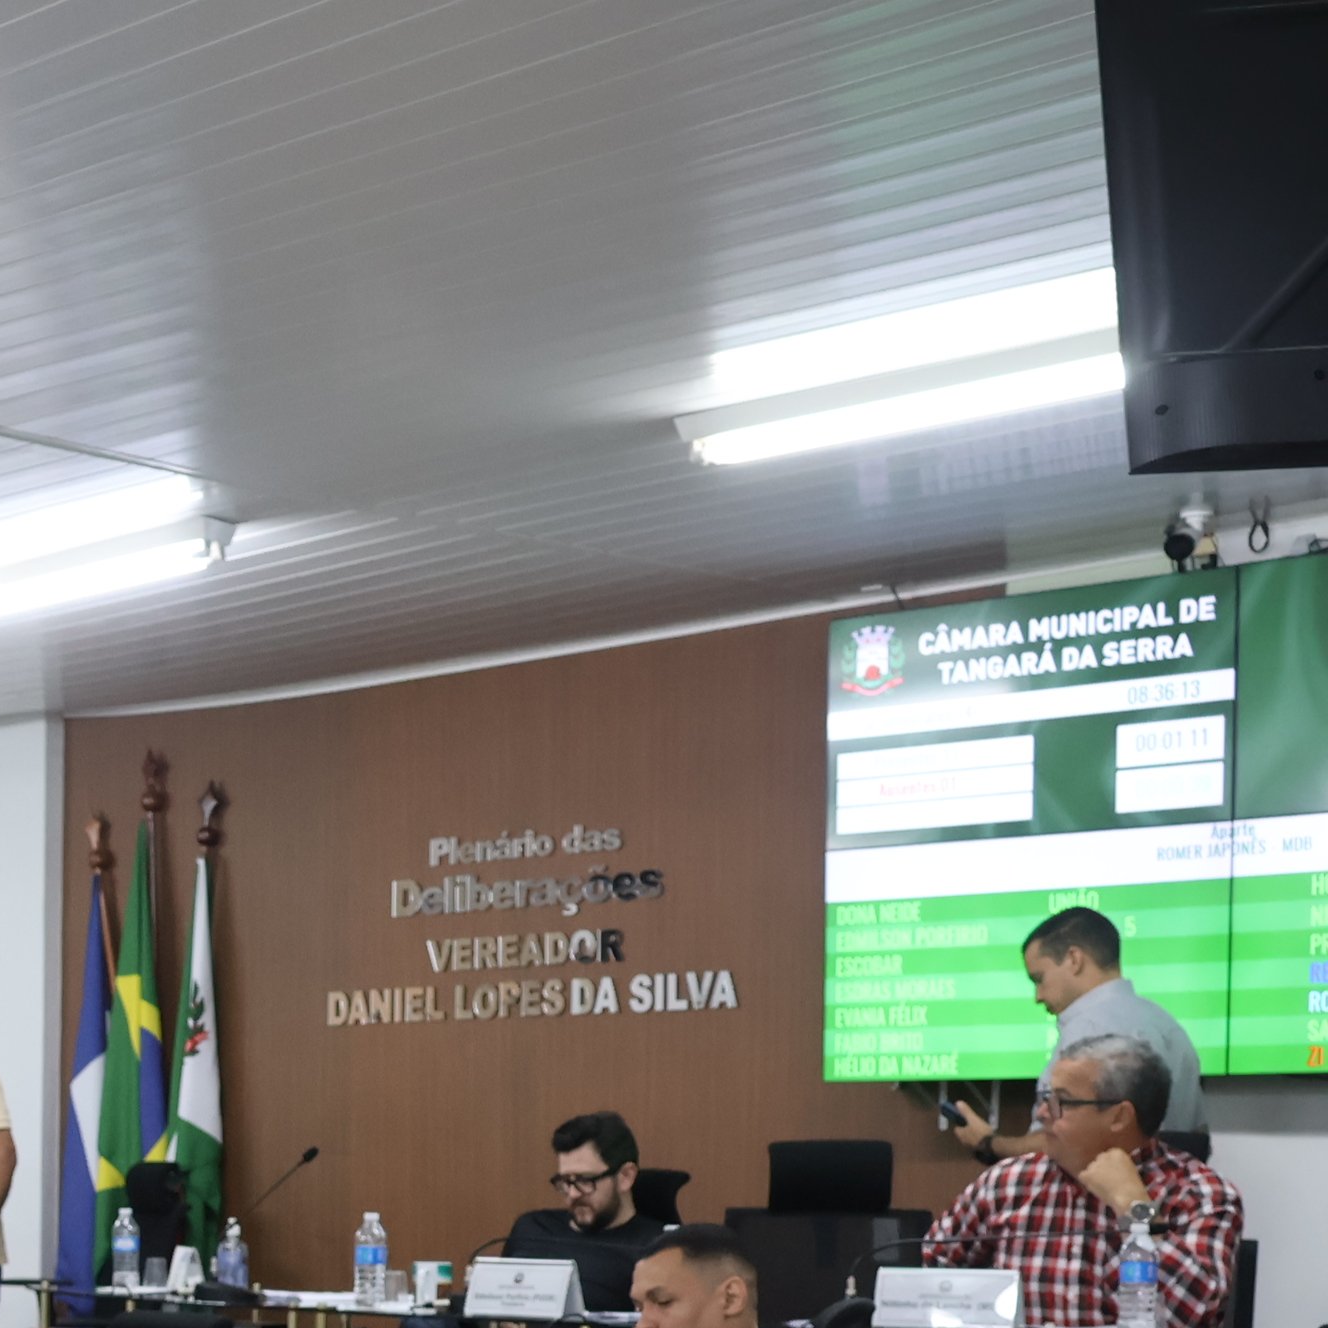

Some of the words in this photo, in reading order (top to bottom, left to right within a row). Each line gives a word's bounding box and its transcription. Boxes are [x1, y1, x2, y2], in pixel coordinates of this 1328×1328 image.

[918, 621, 1024, 655] CÂMARA
[1029, 601, 1174, 642] MUNICIPAL
[1179, 595, 1217, 624] DE
[937, 642, 1056, 685] TANGARÁ
[1062, 645, 1098, 671] DA
[1101, 633, 1194, 666] SERRA
[1128, 679, 1200, 705] 08:36:13
[429, 829, 555, 868] Plenário
[561, 824, 623, 854] das
[1211, 822, 1256, 841] Aparte
[1157, 843, 1202, 861] ROMER
[1207, 836, 1266, 858] JAPONÊS
[1282, 837, 1313, 853] MDB
[391, 865, 665, 918] Deliberações
[836, 904, 877, 926] DONA
[879, 901, 921, 923] NEIDE
[426, 929, 626, 973] VEREADOR
[835, 954, 904, 978] ESCOBAR
[327, 986, 445, 1027] DANIEL
[453, 979, 567, 1020] LOPES
[570, 976, 621, 1015] DA
[628, 970, 739, 1013] SILVA
[834, 1006, 887, 1028] EVANIA
[878, 1055, 900, 1077] DA
[901, 1048, 960, 1077] NAZARÉ
